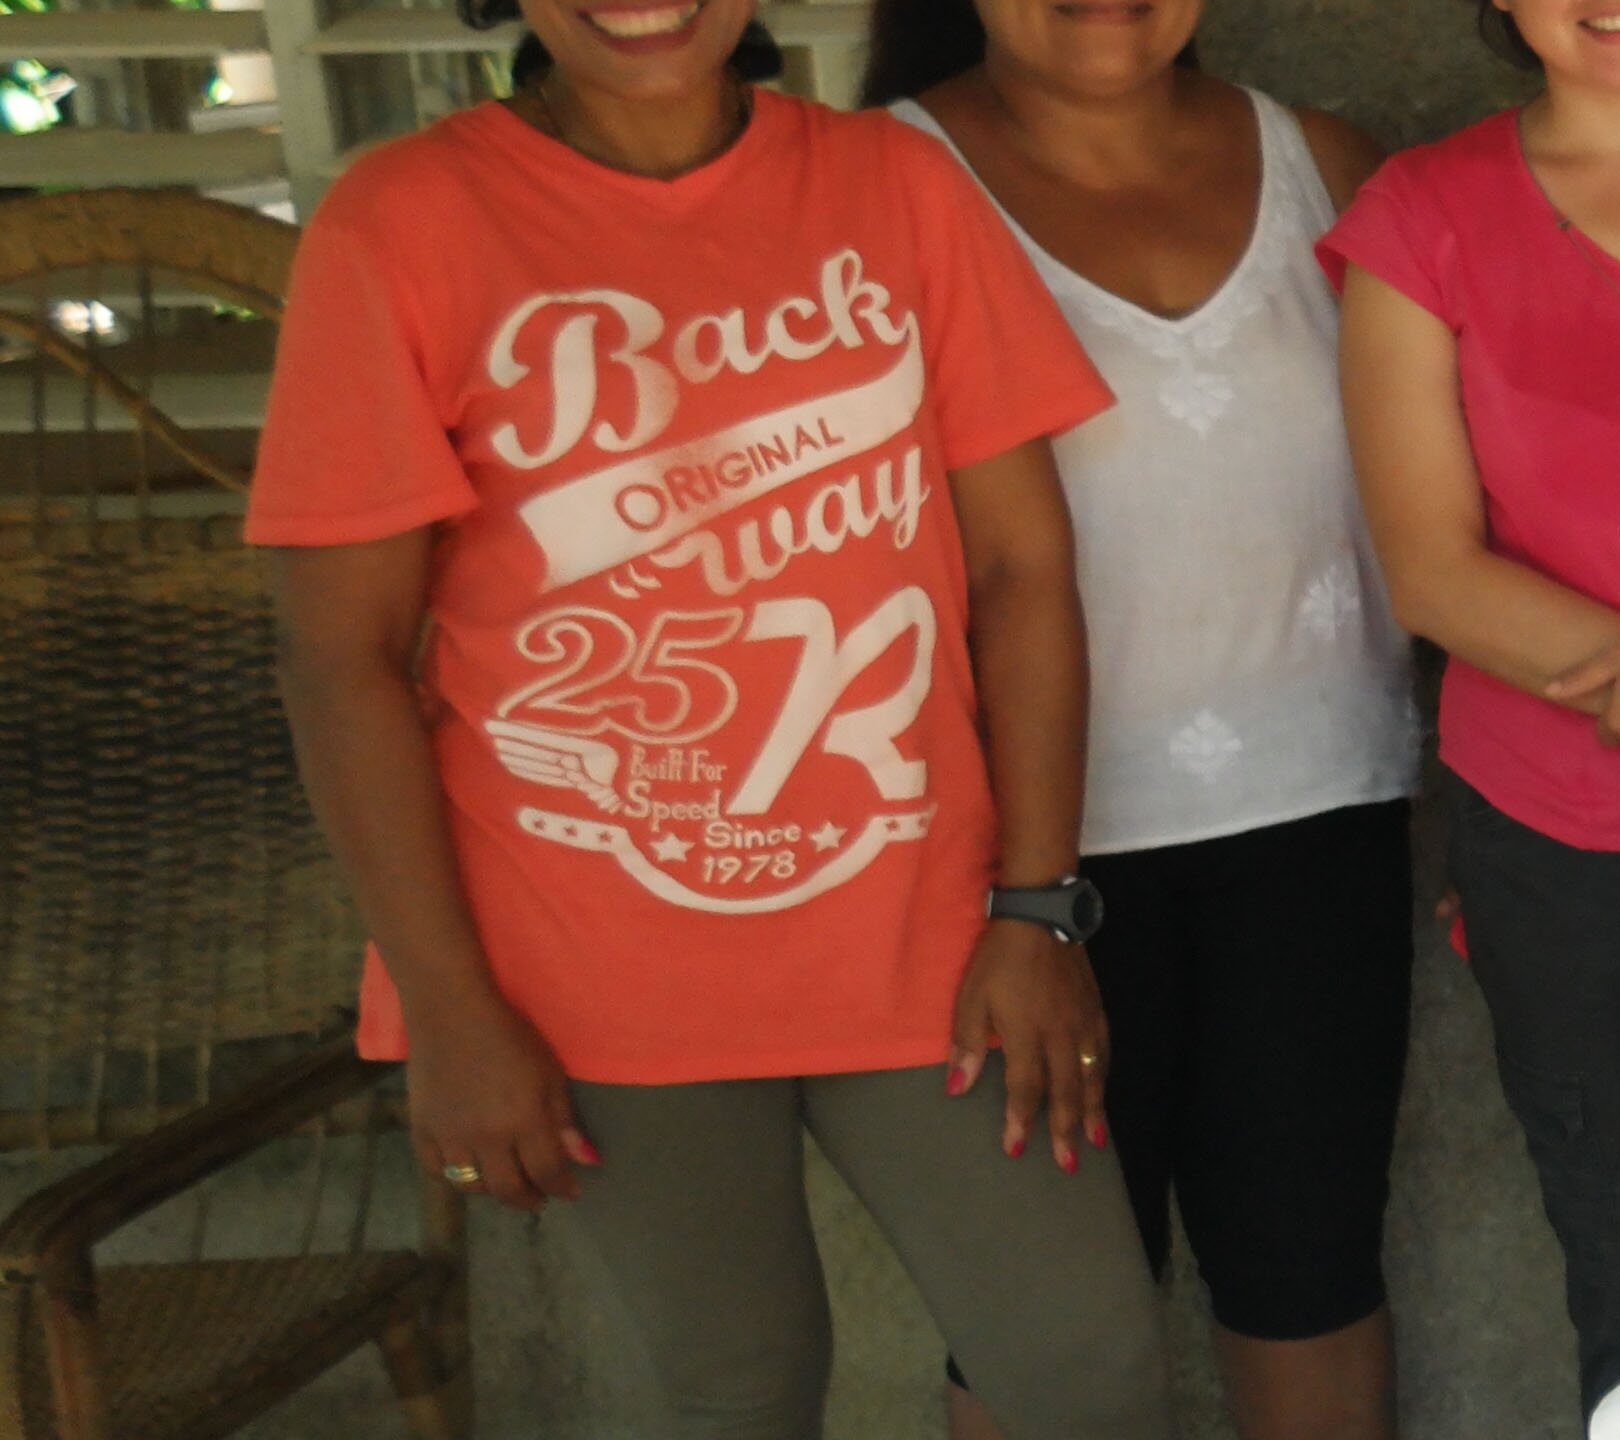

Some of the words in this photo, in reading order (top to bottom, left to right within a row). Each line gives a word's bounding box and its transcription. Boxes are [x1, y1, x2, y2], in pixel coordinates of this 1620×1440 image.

[488, 248, 914, 470] Back
[615, 417, 845, 532] ORIGINAL
[690, 748, 728, 782] For
[624, 780, 722, 833] Speed
[704, 821, 802, 849] Since
[703, 850, 798, 884] 1978
